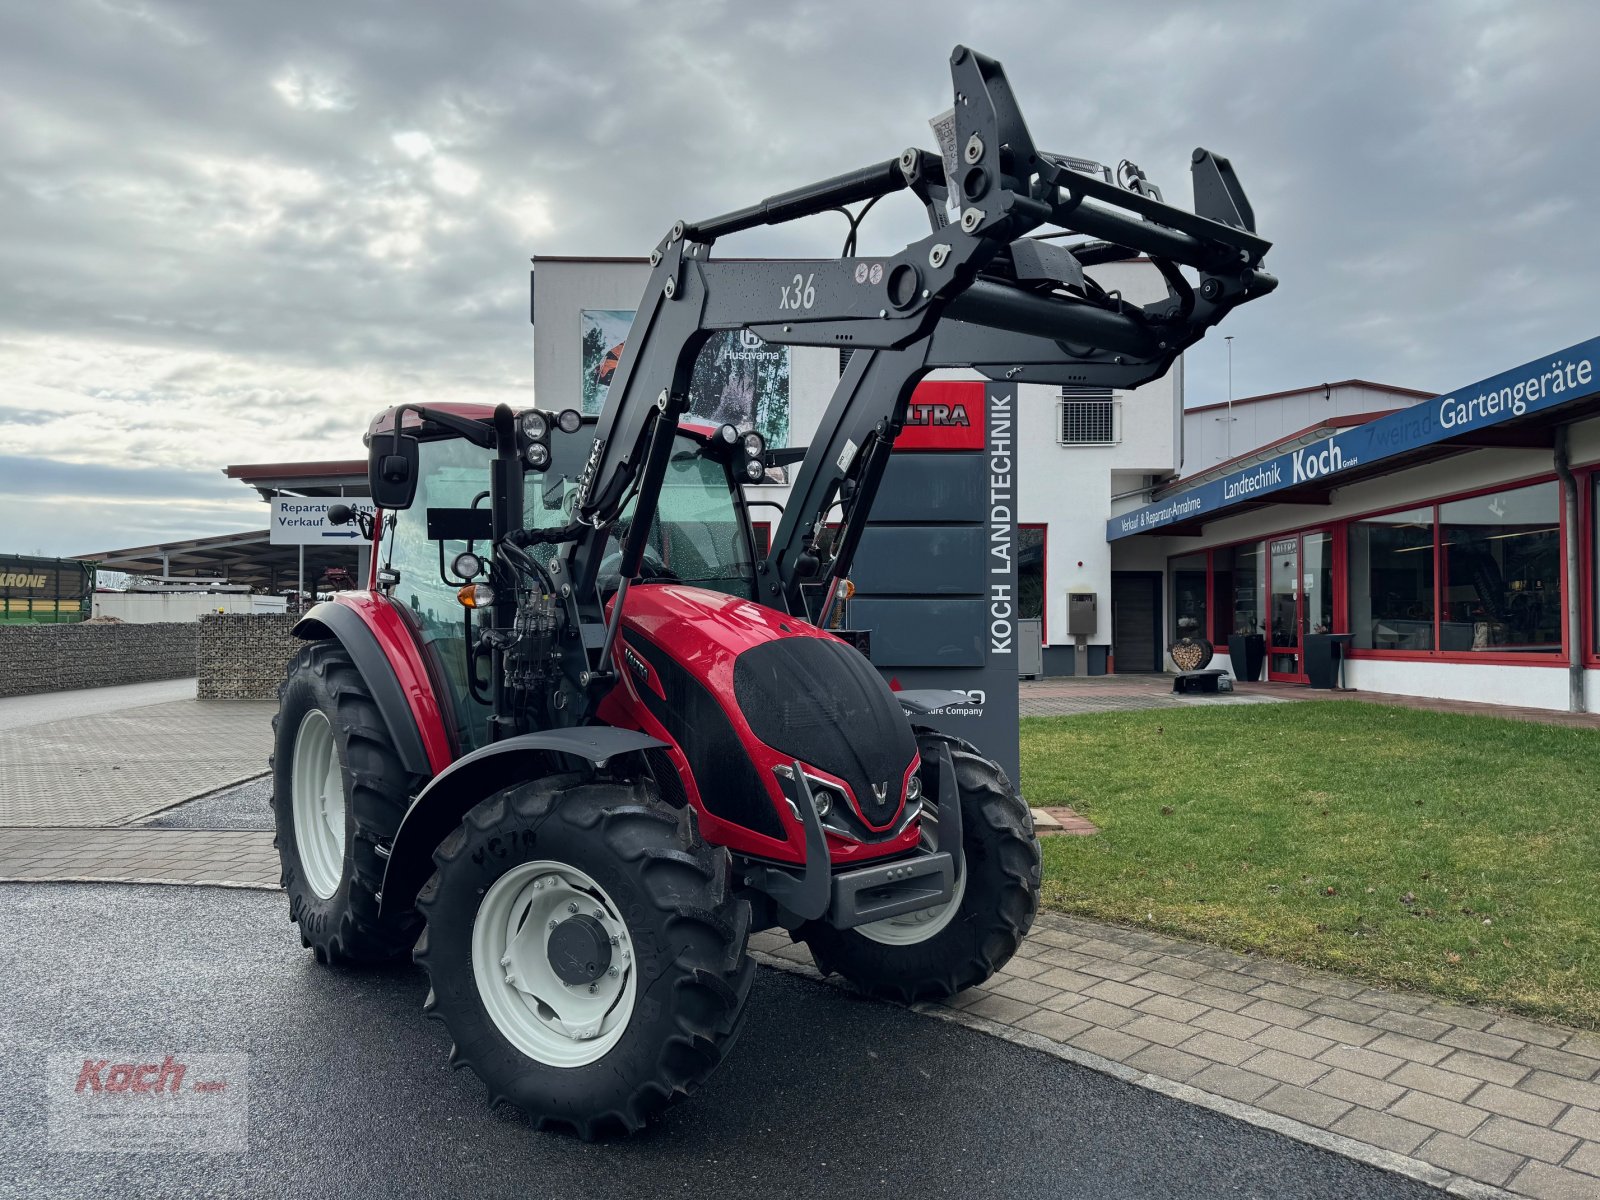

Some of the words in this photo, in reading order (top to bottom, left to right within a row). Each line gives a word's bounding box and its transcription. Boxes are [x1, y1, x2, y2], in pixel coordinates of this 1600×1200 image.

[779, 273, 815, 310] x36
[724, 349, 780, 361] Husqvarna
[1439, 358, 1593, 429] Gartengeräte
[904, 403, 970, 427] LTRA
[1223, 461, 1282, 500] Landtechnik
[1292, 437, 1343, 485] Koch
[1342, 456, 1359, 469] GmbH
[990, 394, 1011, 575] LANDTECHNIK
[278, 516, 325, 527] Verkauf
[281, 502, 329, 515] Reparat
[1121, 513, 1139, 533] Verkauf
[1140, 512, 1146, 527] &
[1145, 495, 1202, 528] Reparatur-Annahme
[0, 572, 47, 588] KRONE
[991, 584, 1011, 654] KOCH
[945, 706, 984, 717] Company
